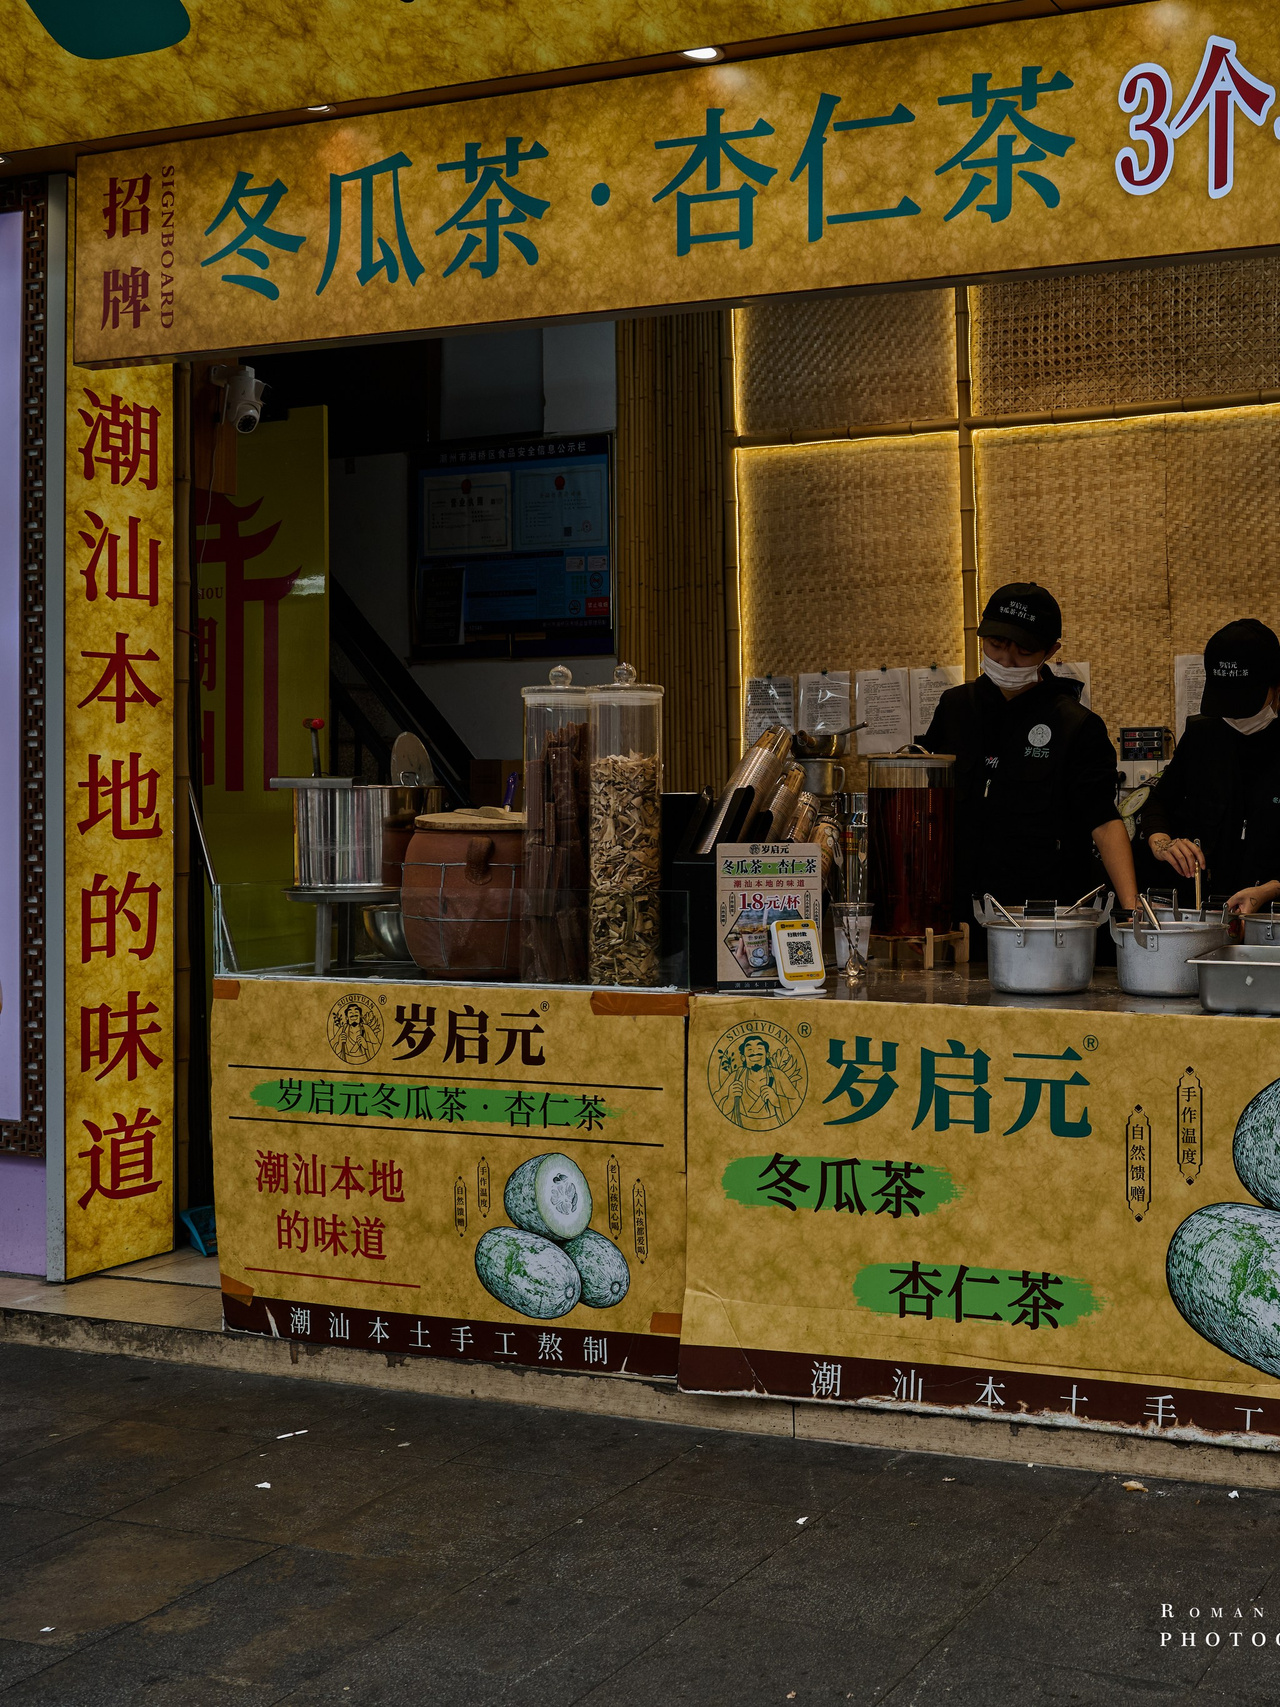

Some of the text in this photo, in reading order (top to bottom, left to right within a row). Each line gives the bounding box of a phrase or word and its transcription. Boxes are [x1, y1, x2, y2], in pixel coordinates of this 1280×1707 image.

[101, 173, 152, 331] 招牌
[161, 165, 175, 329] SIGNBOARD
[1024, 746, 1050, 758] 岁启元
[77, 387, 163, 1211] 潮汕本地的味道
[761, 844, 789, 854] 岁启元
[733, 880, 805, 888] 潮汕本地的味道
[739, 893, 801, 910] 18元/杯
[337, 995, 374, 1009] SUIQIYUAN
[391, 1004, 547, 1066] 岁启元
[726, 1021, 792, 1044] SUIQIYUAN
[821, 1036, 1093, 1138] 岁启元
[1181, 1086, 1197, 1165] 手作温度
[255, 1149, 406, 1204] 潮汕本地
[756, 1152, 926, 1219] 冬瓜茶
[1130, 1124, 1146, 1203] 自然馈赠
[277, 1208, 388, 1261] 的味道
[888, 1260, 1066, 1330] 杏仁茶
[290, 1306, 609, 1365] 潮汕本土手工熬制
